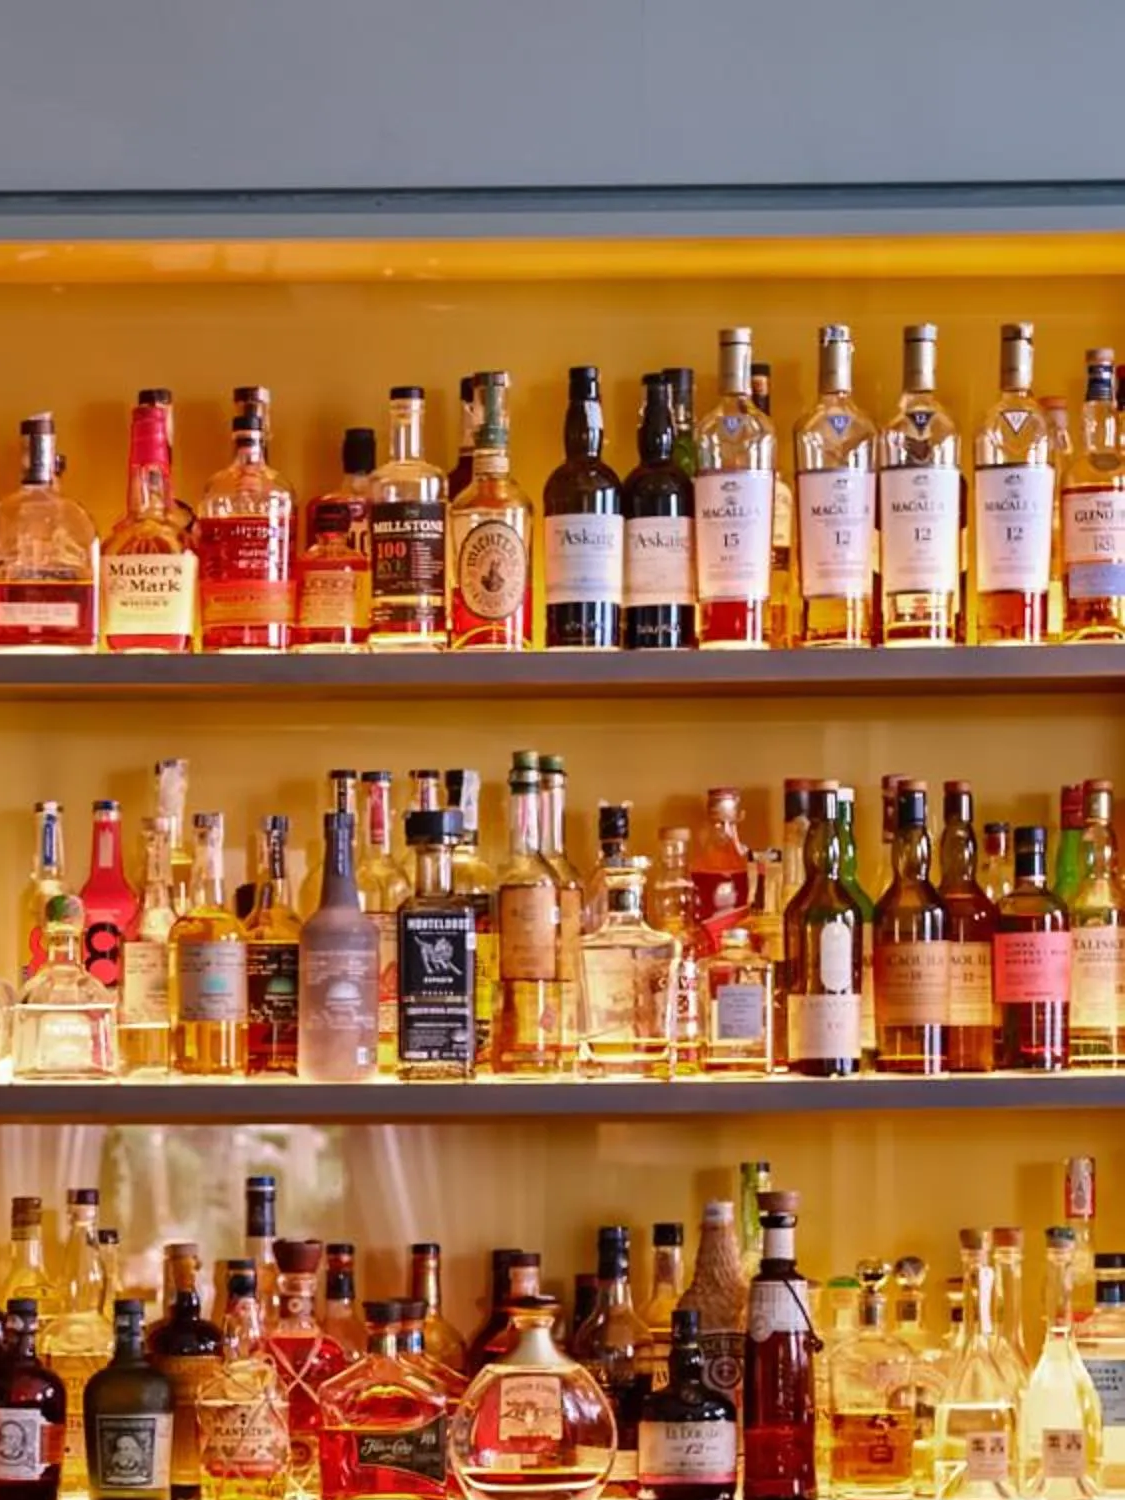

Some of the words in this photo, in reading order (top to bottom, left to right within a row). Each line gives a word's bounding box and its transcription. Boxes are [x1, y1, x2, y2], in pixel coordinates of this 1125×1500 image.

[723, 533, 740, 548] 15
[834, 530, 852, 545] 12
[914, 527, 932, 541] 12
[1006, 527, 1024, 541] 12
[377, 541, 407, 559] 100
[109, 562, 183, 577] Maker's
[129, 578, 181, 592] Mark
